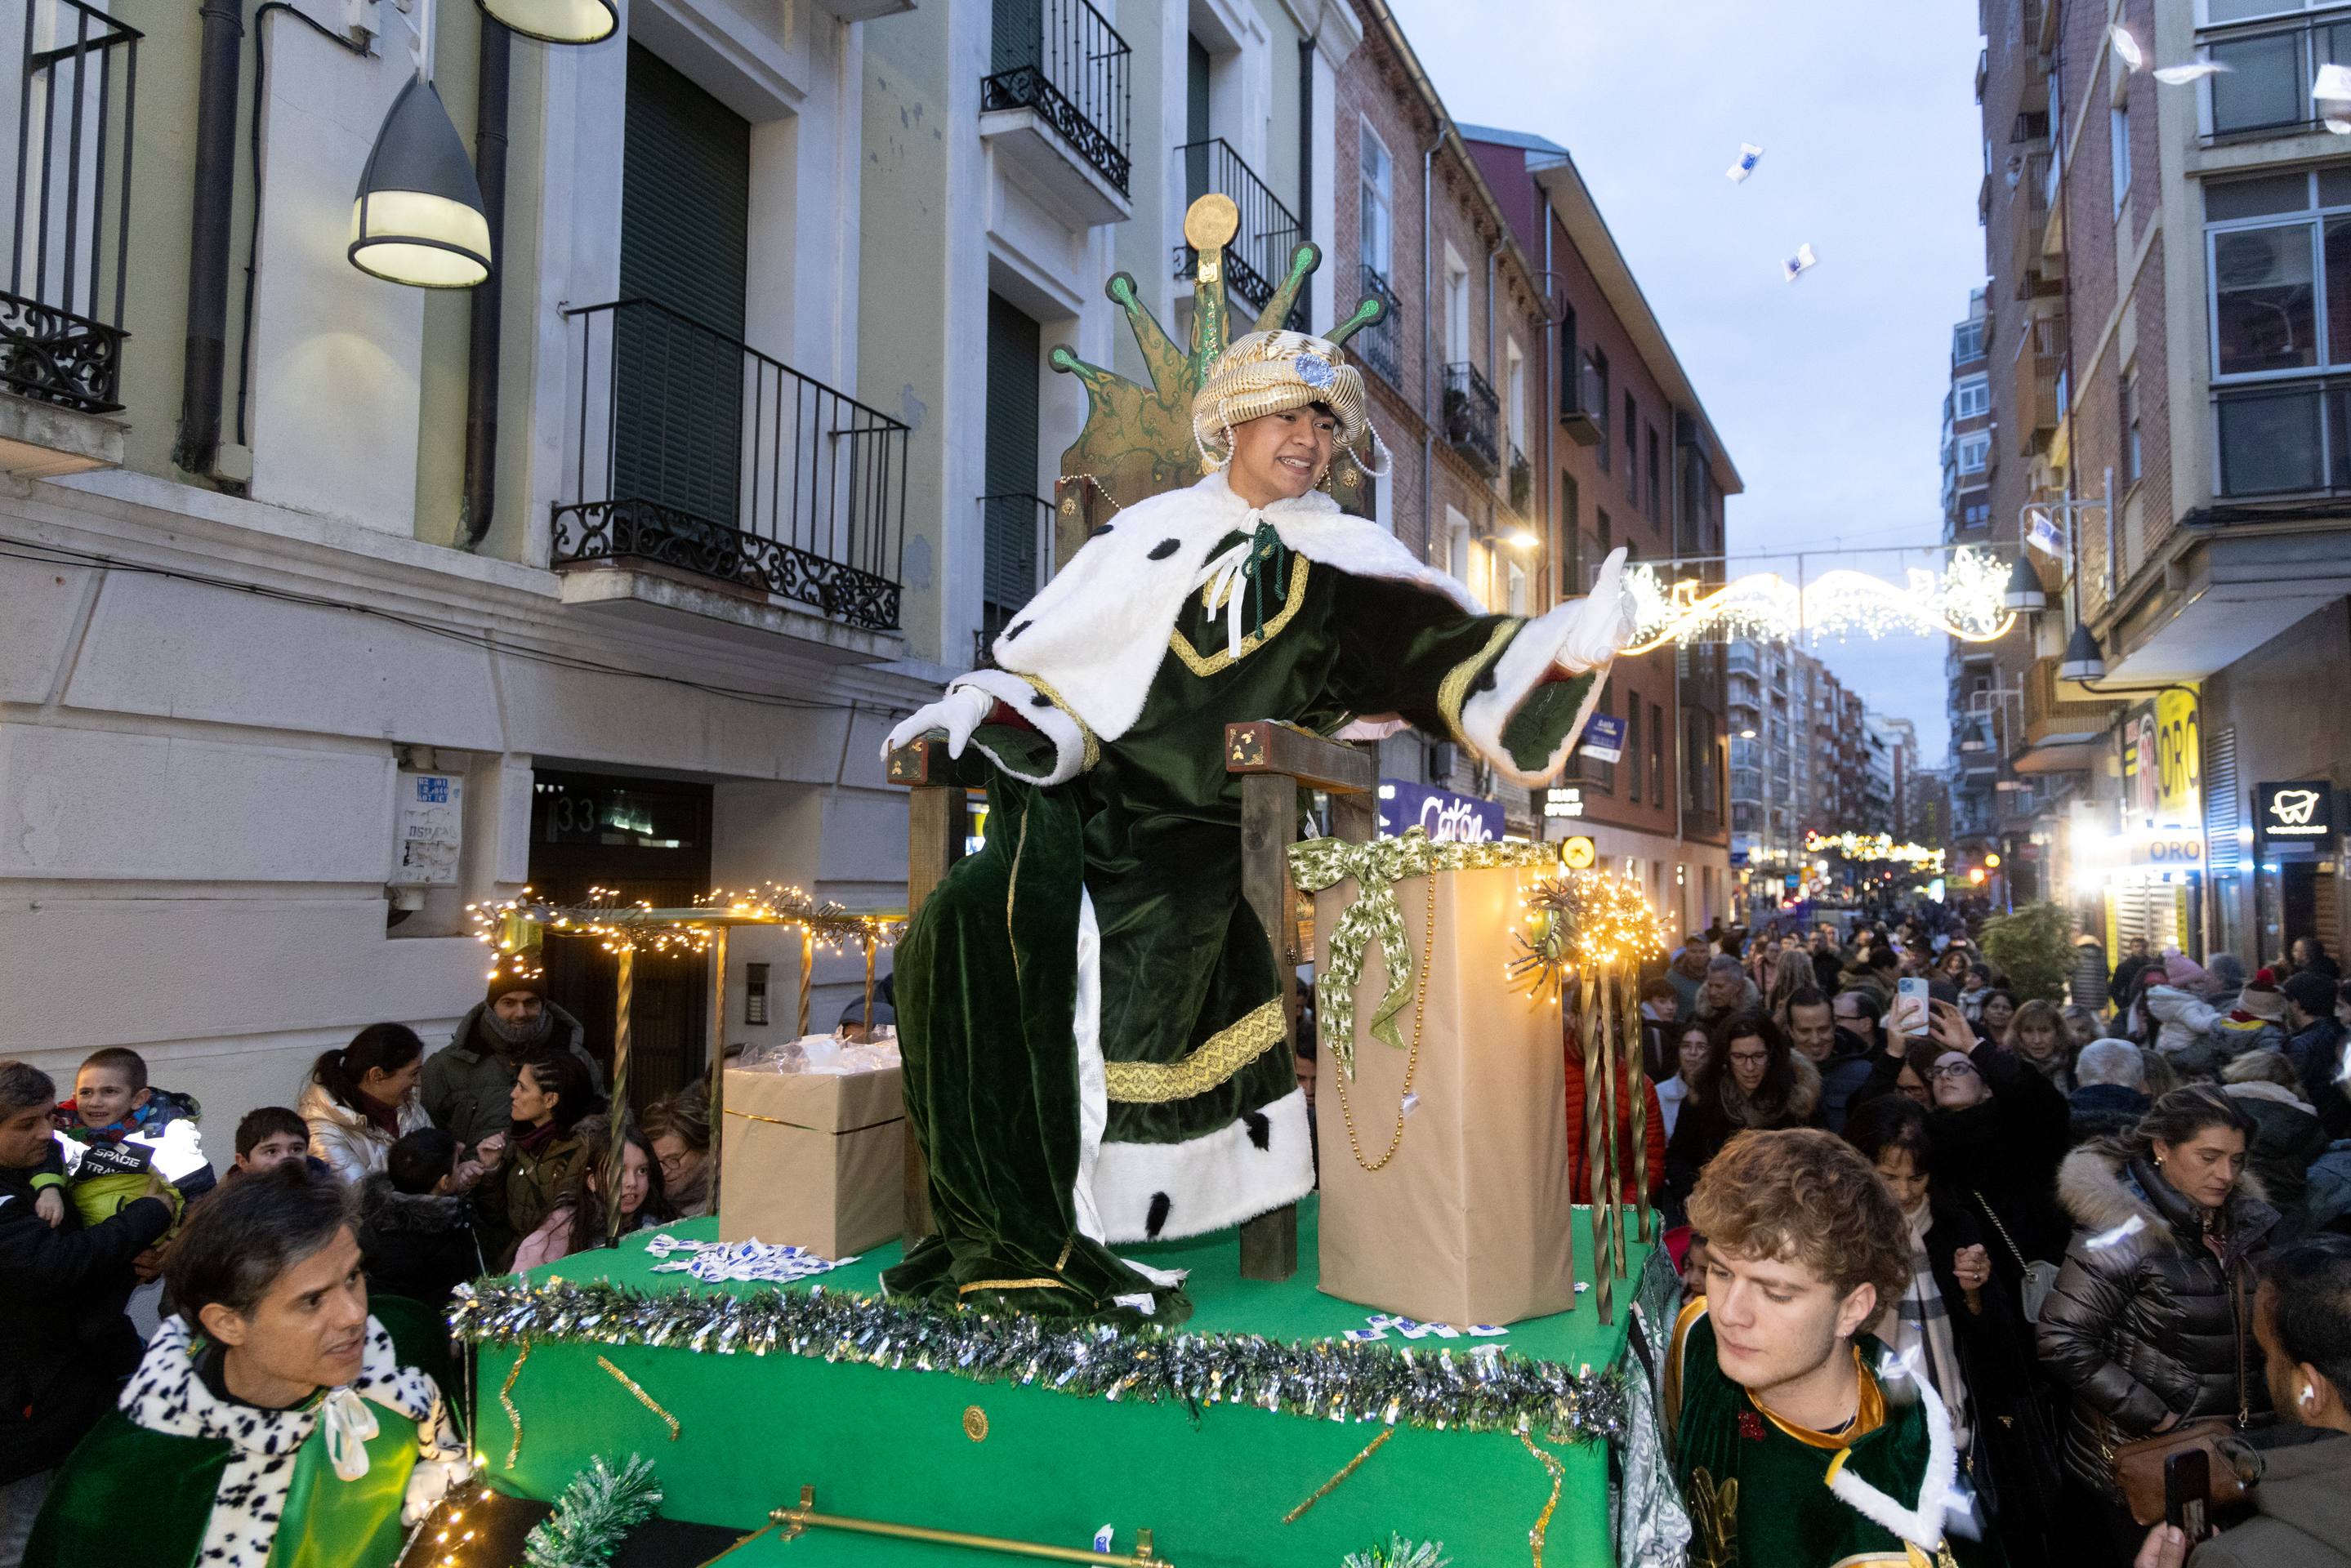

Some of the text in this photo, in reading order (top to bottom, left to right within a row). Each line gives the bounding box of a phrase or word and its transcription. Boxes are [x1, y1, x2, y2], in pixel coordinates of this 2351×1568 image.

[557, 795, 595, 833] 33
[2150, 841, 2201, 861] ORO
[94, 1148, 141, 1168] SPACE
